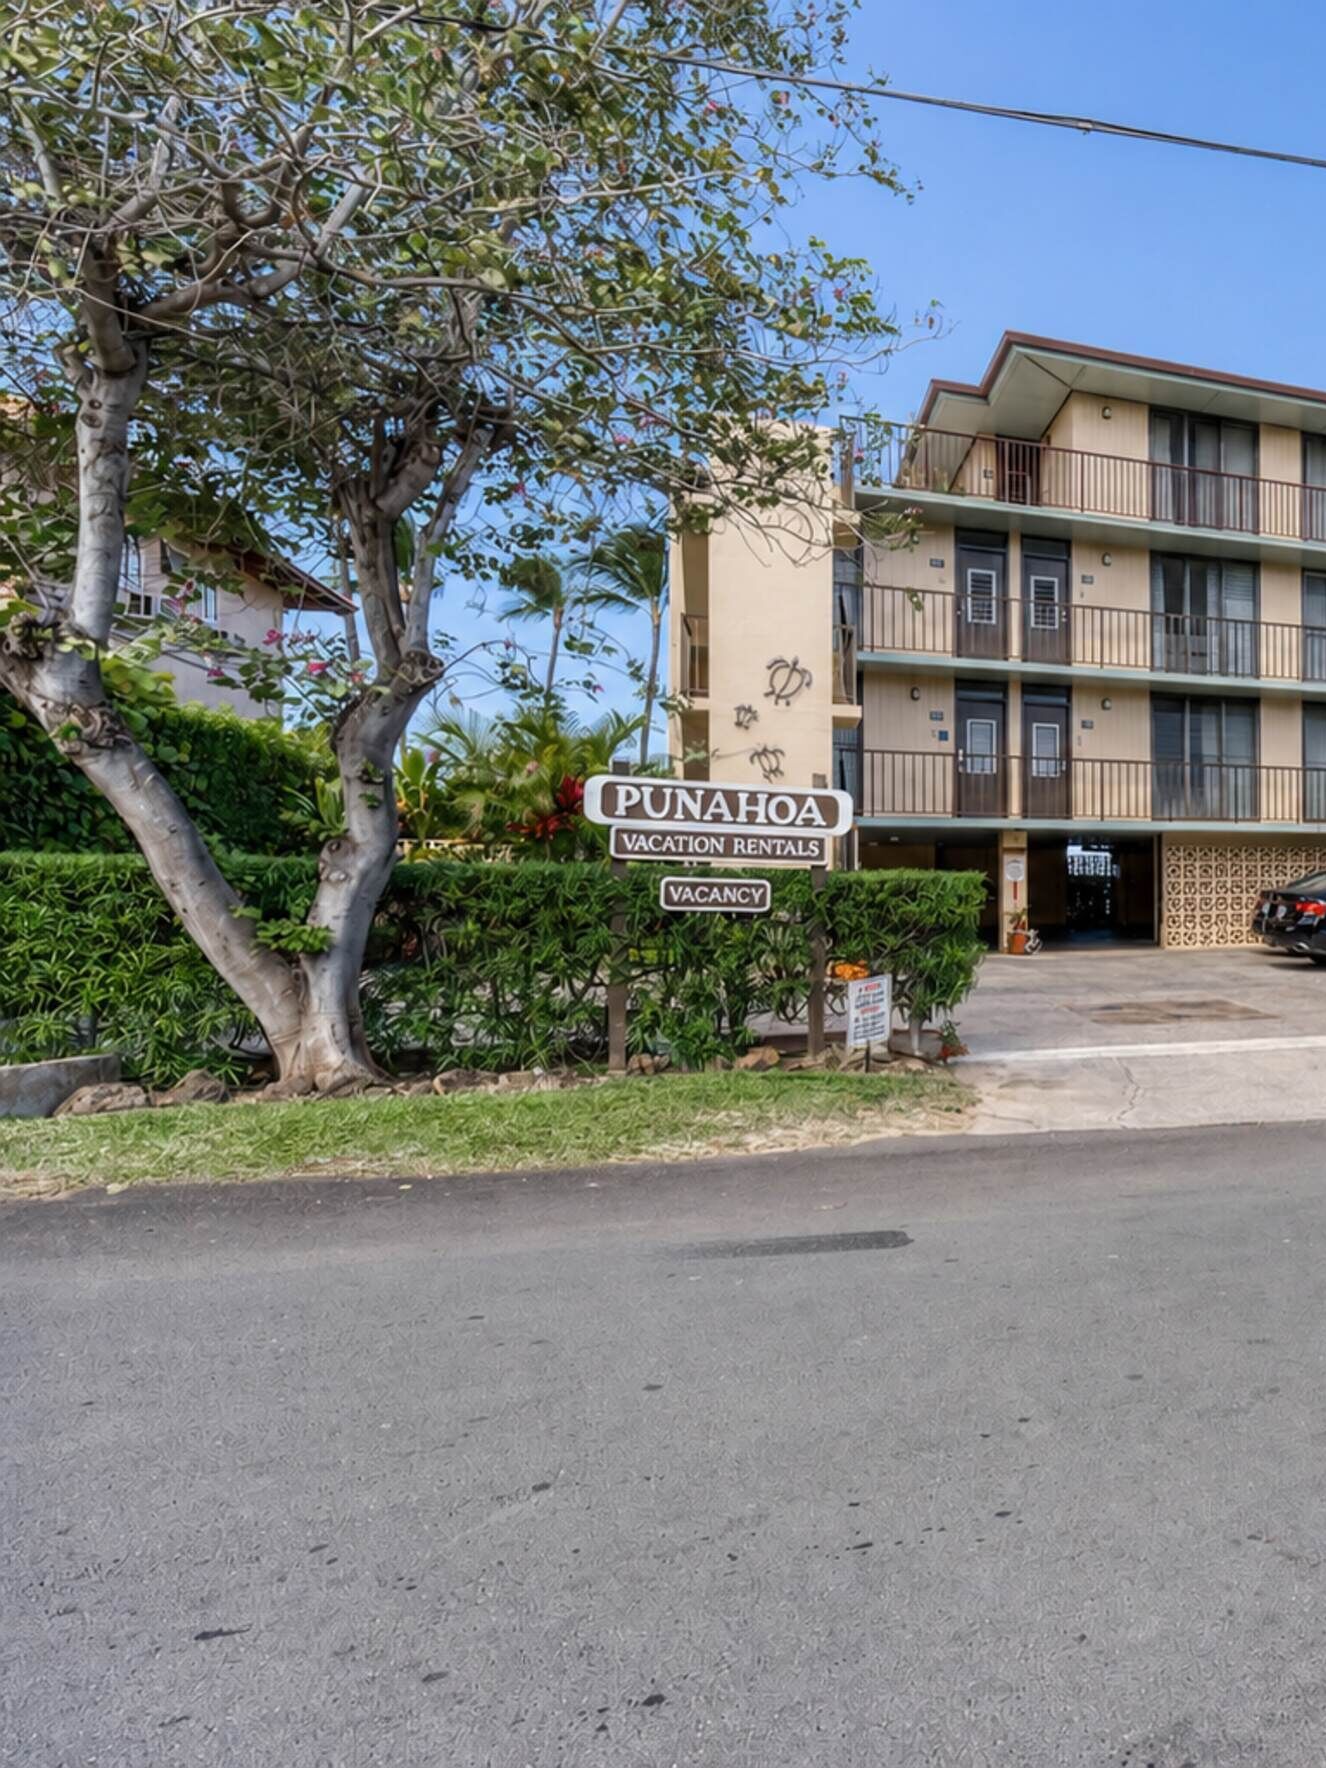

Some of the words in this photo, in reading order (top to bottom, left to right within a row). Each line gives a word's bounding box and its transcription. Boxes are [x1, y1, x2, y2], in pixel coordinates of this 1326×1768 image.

[614, 785, 826, 826] PUNAHOA
[621, 833, 725, 855] VACATION
[733, 836, 820, 858] RENTALS
[669, 885, 764, 904] VACANCY
